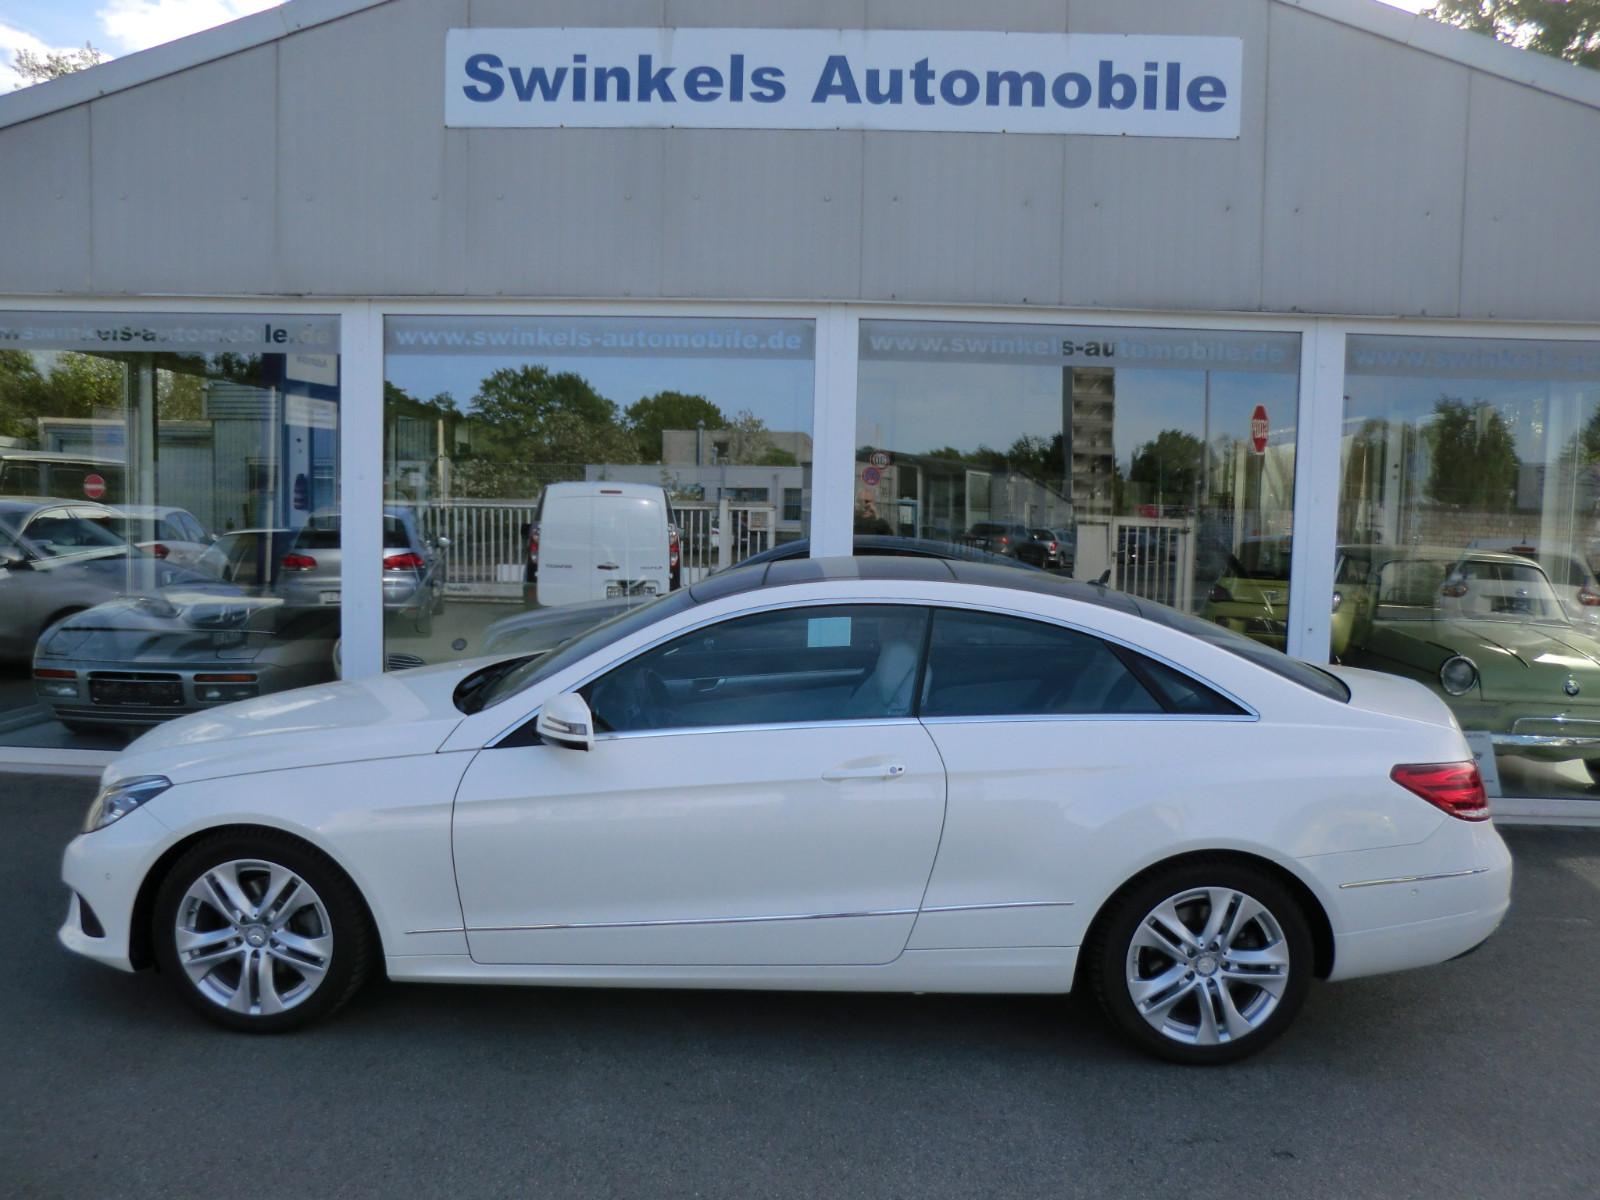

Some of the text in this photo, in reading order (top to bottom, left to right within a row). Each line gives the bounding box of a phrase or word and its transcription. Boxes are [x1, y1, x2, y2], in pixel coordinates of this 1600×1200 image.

[463, 53, 1227, 113] Swinkels Automobile
[395, 326, 801, 350] www.swinkels-automobile.de
[869, 332, 1286, 364] www.swinkels-automobile.de
